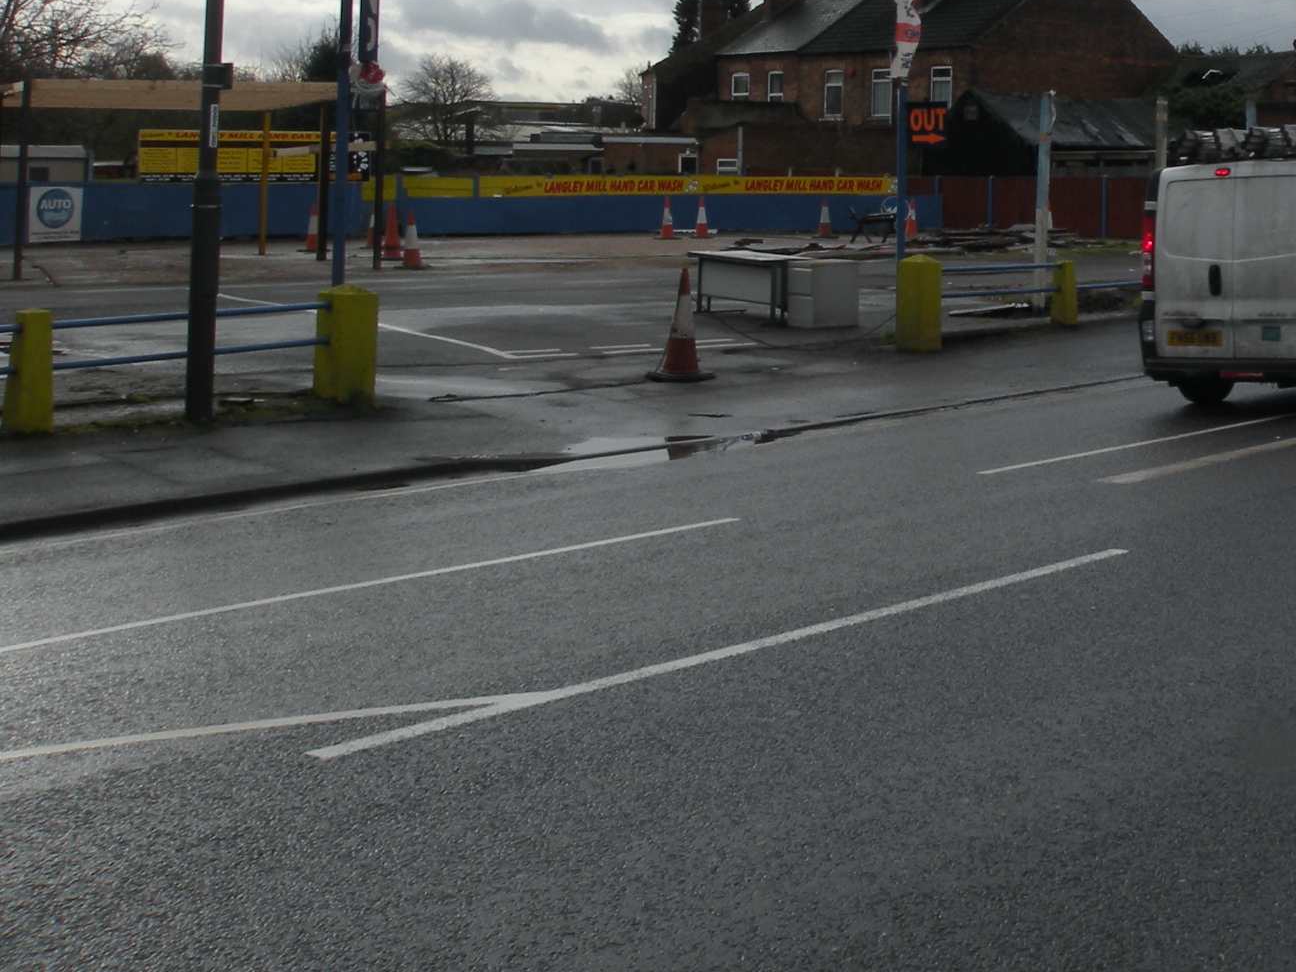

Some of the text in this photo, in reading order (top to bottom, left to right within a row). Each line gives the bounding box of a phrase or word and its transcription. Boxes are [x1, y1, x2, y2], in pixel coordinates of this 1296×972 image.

[910, 108, 947, 131] OUT
[544, 181, 584, 193] LANGLEY
[585, 180, 608, 193] MILL
[609, 180, 636, 192] HAND
[637, 180, 655, 192] CAR
[657, 179, 684, 192] WASH
[744, 180, 785, 192] LANGLEY
[785, 180, 808, 192] MILL
[809, 180, 834, 191] HAND
[836, 180, 855, 191] CAR
[856, 179, 882, 191] WASH
[40, 198, 72, 210] AUTO
